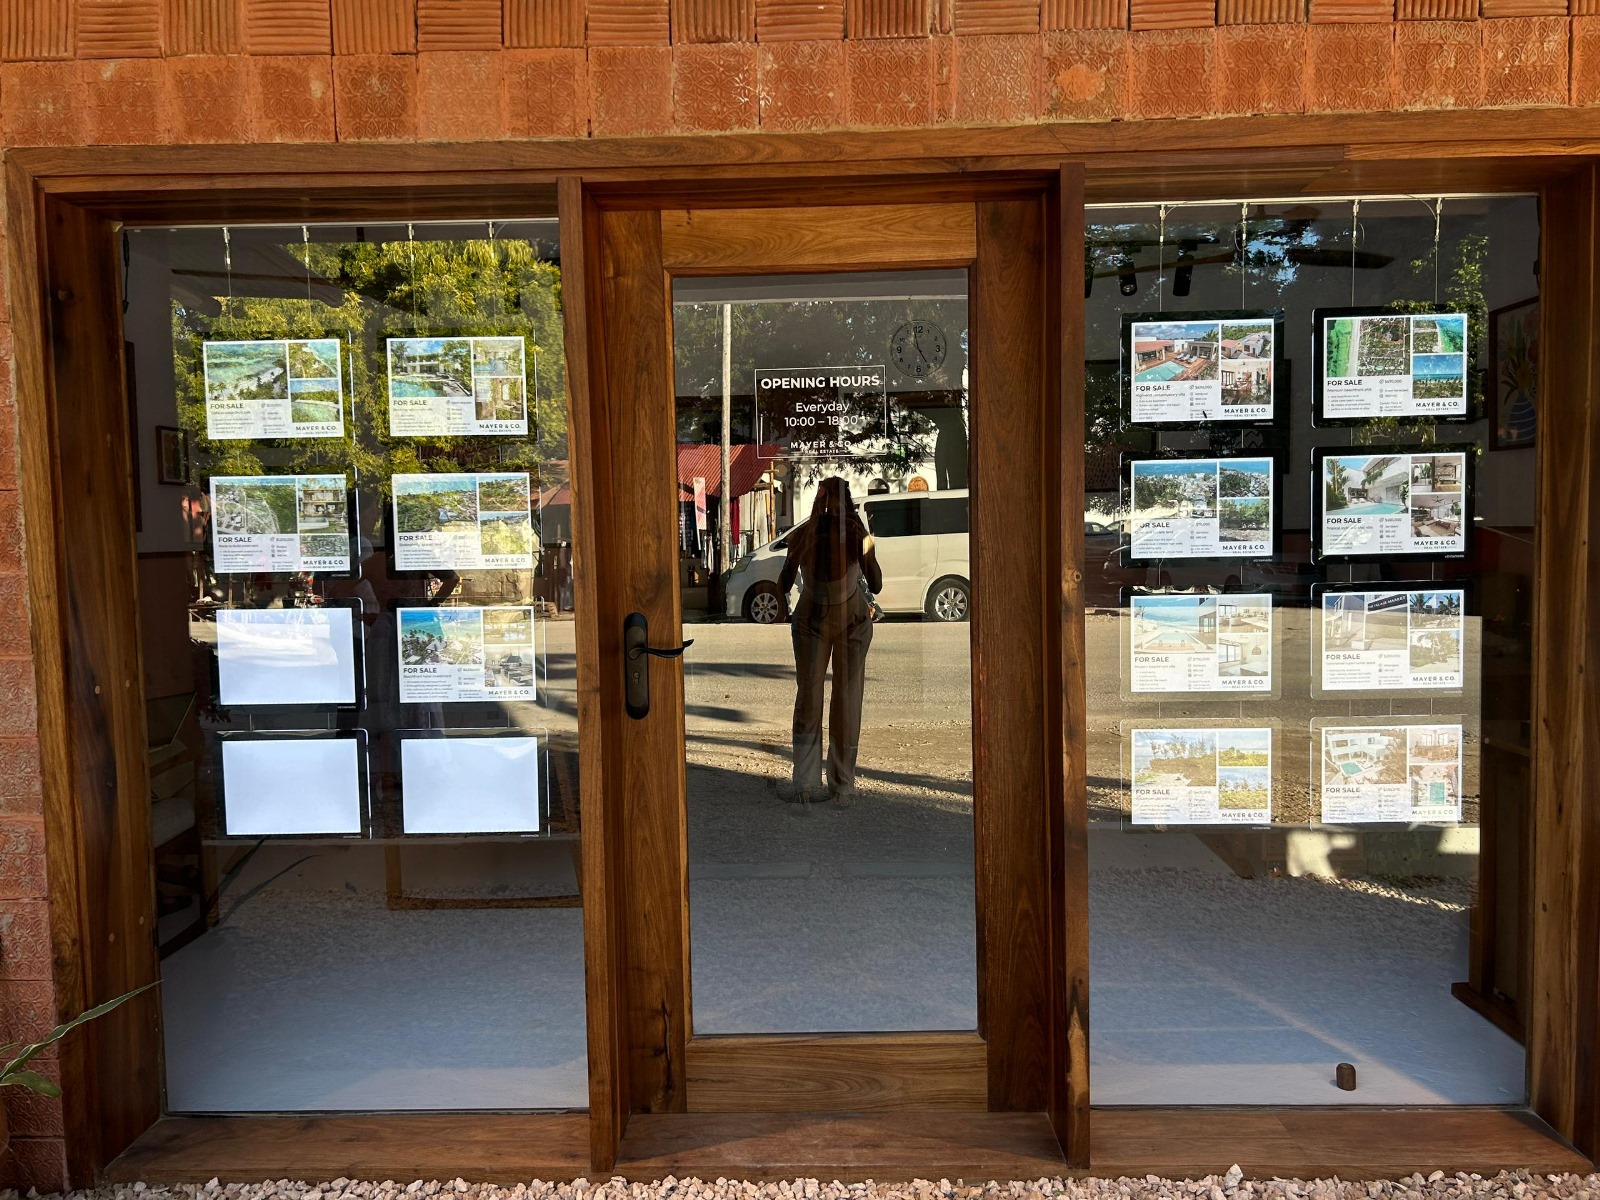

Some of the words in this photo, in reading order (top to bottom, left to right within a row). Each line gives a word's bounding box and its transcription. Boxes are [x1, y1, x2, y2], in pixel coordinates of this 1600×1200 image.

[896, 346, 902, 354] 9
[760, 377, 826, 389] OPENING
[829, 375, 880, 387] HOURS
[795, 401, 849, 413] Everyday
[784, 416, 815, 427] 10:00
[826, 415, 858, 426] 18:00
[790, 441, 826, 449] MAYER
